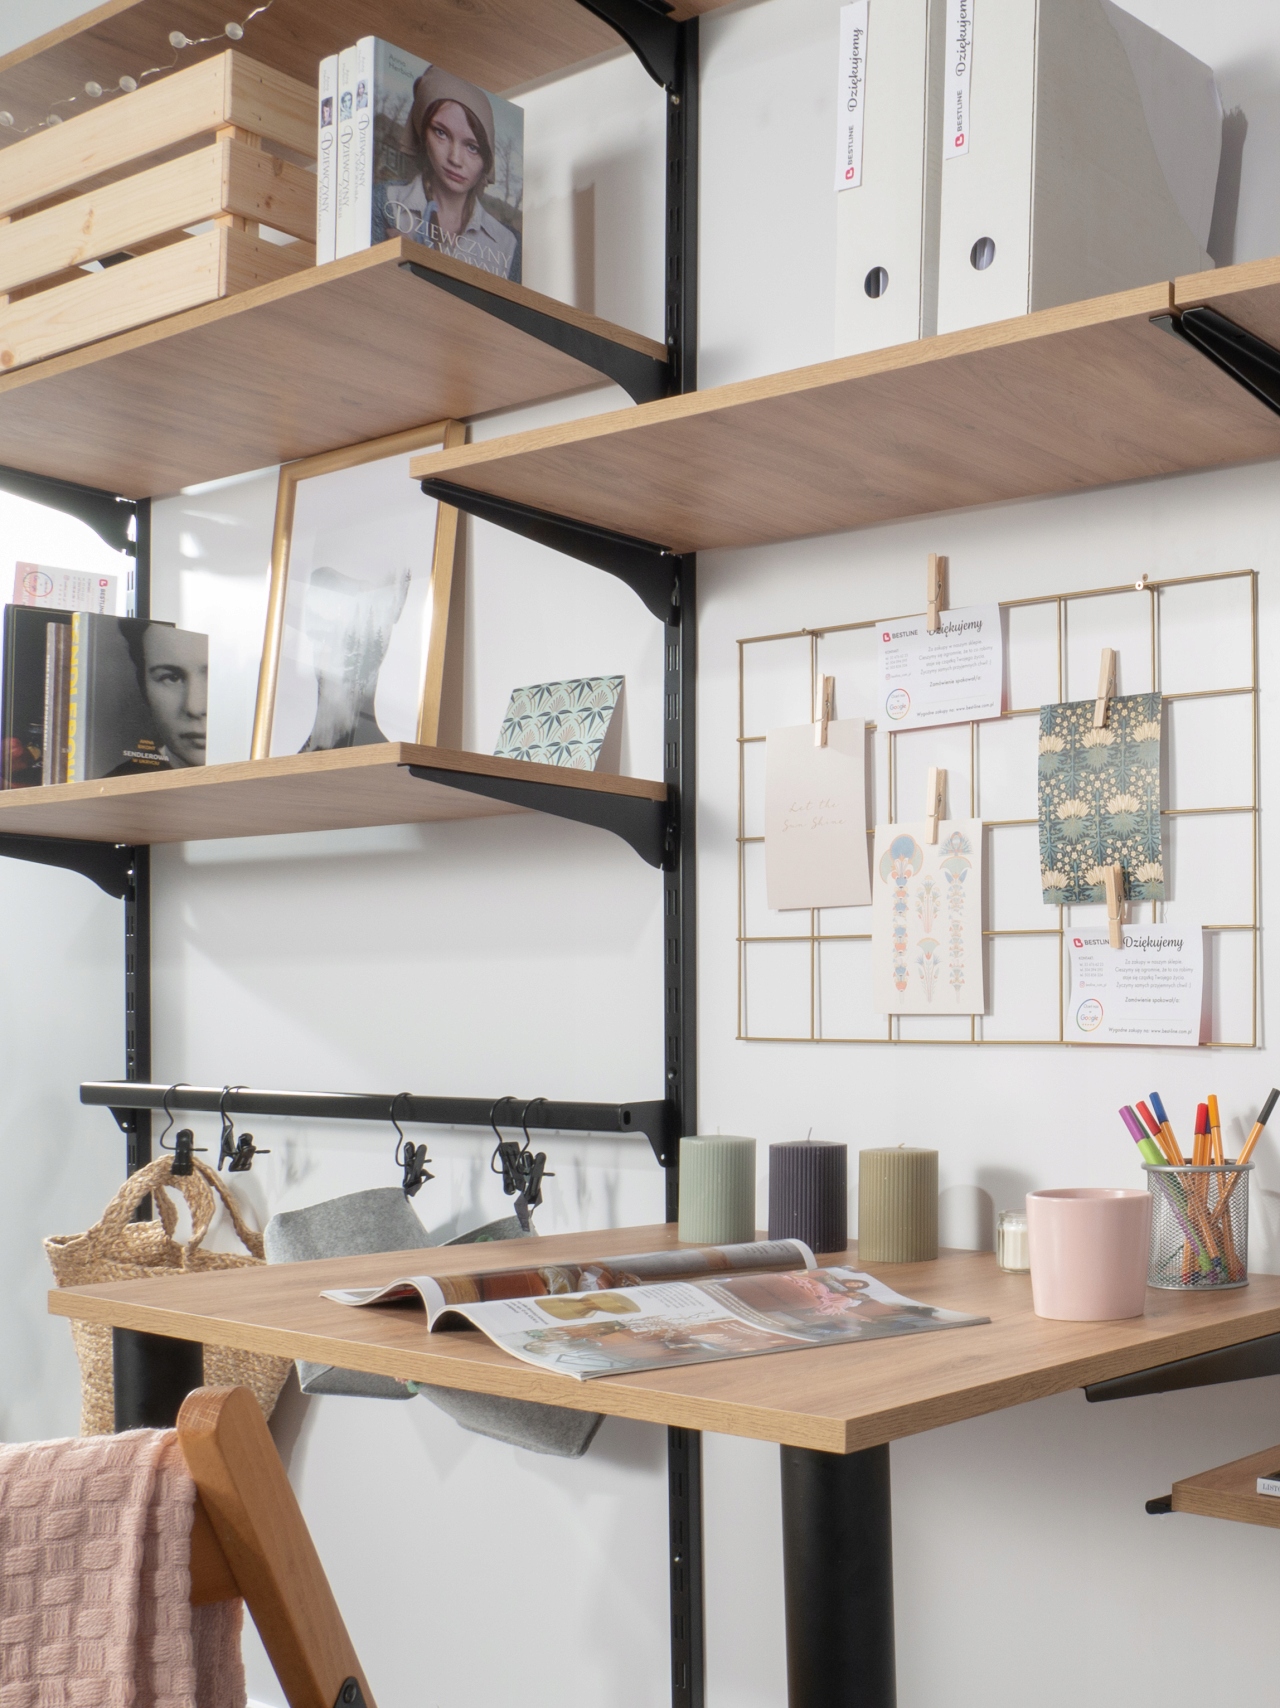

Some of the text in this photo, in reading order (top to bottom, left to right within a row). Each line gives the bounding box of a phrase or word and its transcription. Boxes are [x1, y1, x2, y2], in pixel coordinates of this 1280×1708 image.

[955, 0, 972, 77] Dziękujem
[847, 28, 864, 113] Dziękujemy
[384, 200, 512, 269] DZIEWCZYNY
[892, 629, 918, 639] BESTLINE
[889, 703, 907, 711] Google
[1122, 935, 1184, 952] Dziękujemy
[1080, 1014, 1098, 1022] Google
